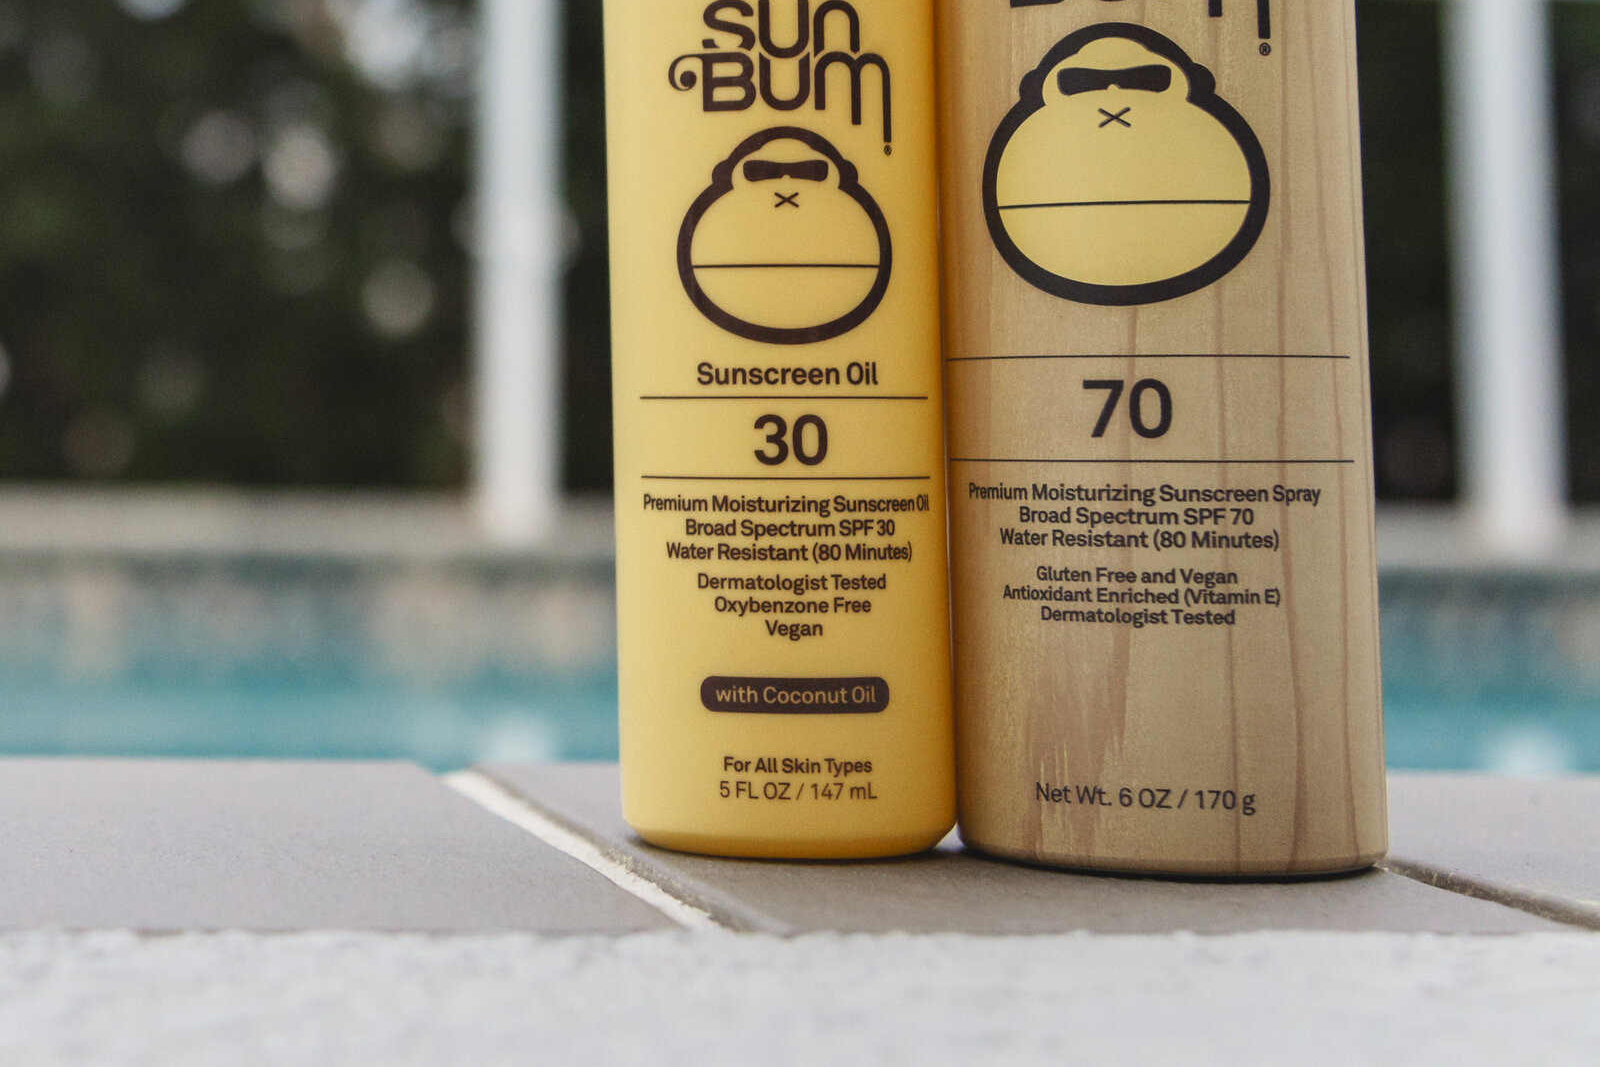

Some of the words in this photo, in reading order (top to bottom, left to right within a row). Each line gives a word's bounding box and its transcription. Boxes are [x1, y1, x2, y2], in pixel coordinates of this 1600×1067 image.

[697, 362, 840, 387] Sunscreen
[847, 363, 878, 386] Oil
[1083, 379, 1172, 439] 70
[753, 414, 828, 466] 30
[644, 495, 708, 513] Premium
[712, 495, 830, 516] Moisturizing
[833, 495, 915, 513] Sunscreen
[917, 495, 929, 512] Oil
[969, 483, 1027, 500] Premium
[1032, 484, 1156, 506] Moisturizing
[1159, 485, 1269, 503] Sunscreen
[1273, 485, 1320, 507] Spray
[1019, 506, 1071, 524] Broad
[1076, 507, 1179, 529] Spectrum
[1183, 508, 1227, 526] SPF
[1230, 508, 1254, 526] 70
[686, 519, 736, 536] Broad
[741, 519, 835, 540] Spectrum
[839, 520, 874, 536] SPF
[877, 520, 895, 536] 30
[1000, 528, 1048, 547] Water
[1052, 529, 1148, 548] Resistant
[1153, 529, 1186, 552] (80
[1191, 529, 1279, 551] Minutes)
[666, 542, 713, 560] Water
[717, 543, 808, 561] Resistant
[812, 543, 841, 564] (80
[845, 542, 912, 563] Minutes)
[698, 573, 827, 595] Dermatologist
[830, 574, 886, 591] Tested
[1036, 567, 1091, 583] Gluten
[1096, 567, 1136, 584] Free
[1140, 568, 1175, 585] and
[1180, 569, 1238, 589] Vegan
[1003, 585, 1092, 603] Antioxidant
[1096, 587, 1179, 605] Enriched
[1184, 587, 1261, 607] (Vitamin
[1265, 588, 1281, 606] E)
[714, 597, 829, 618] Oxybenzone
[834, 598, 871, 614] Free
[1041, 606, 1168, 628] Dermatologist
[1173, 608, 1236, 626] Tested
[765, 620, 823, 641] Vegan
[716, 686, 758, 704] with
[763, 686, 847, 705] Coconut
[852, 686, 876, 703] Oil
[724, 757, 751, 773] For
[755, 757, 777, 773] All
[782, 758, 821, 775] Skin
[824, 758, 872, 778] Types
[719, 781, 729, 798] 5
[735, 781, 759, 799] FL
[763, 782, 791, 800] OZ
[811, 782, 844, 801] 147
[850, 782, 877, 801] mL
[1036, 782, 1071, 804] Net
[1075, 785, 1112, 807] Wt.
[1119, 788, 1132, 807] 6
[1139, 789, 1172, 809] OZ
[1195, 790, 1236, 810] 170
[1242, 794, 1256, 814] g
